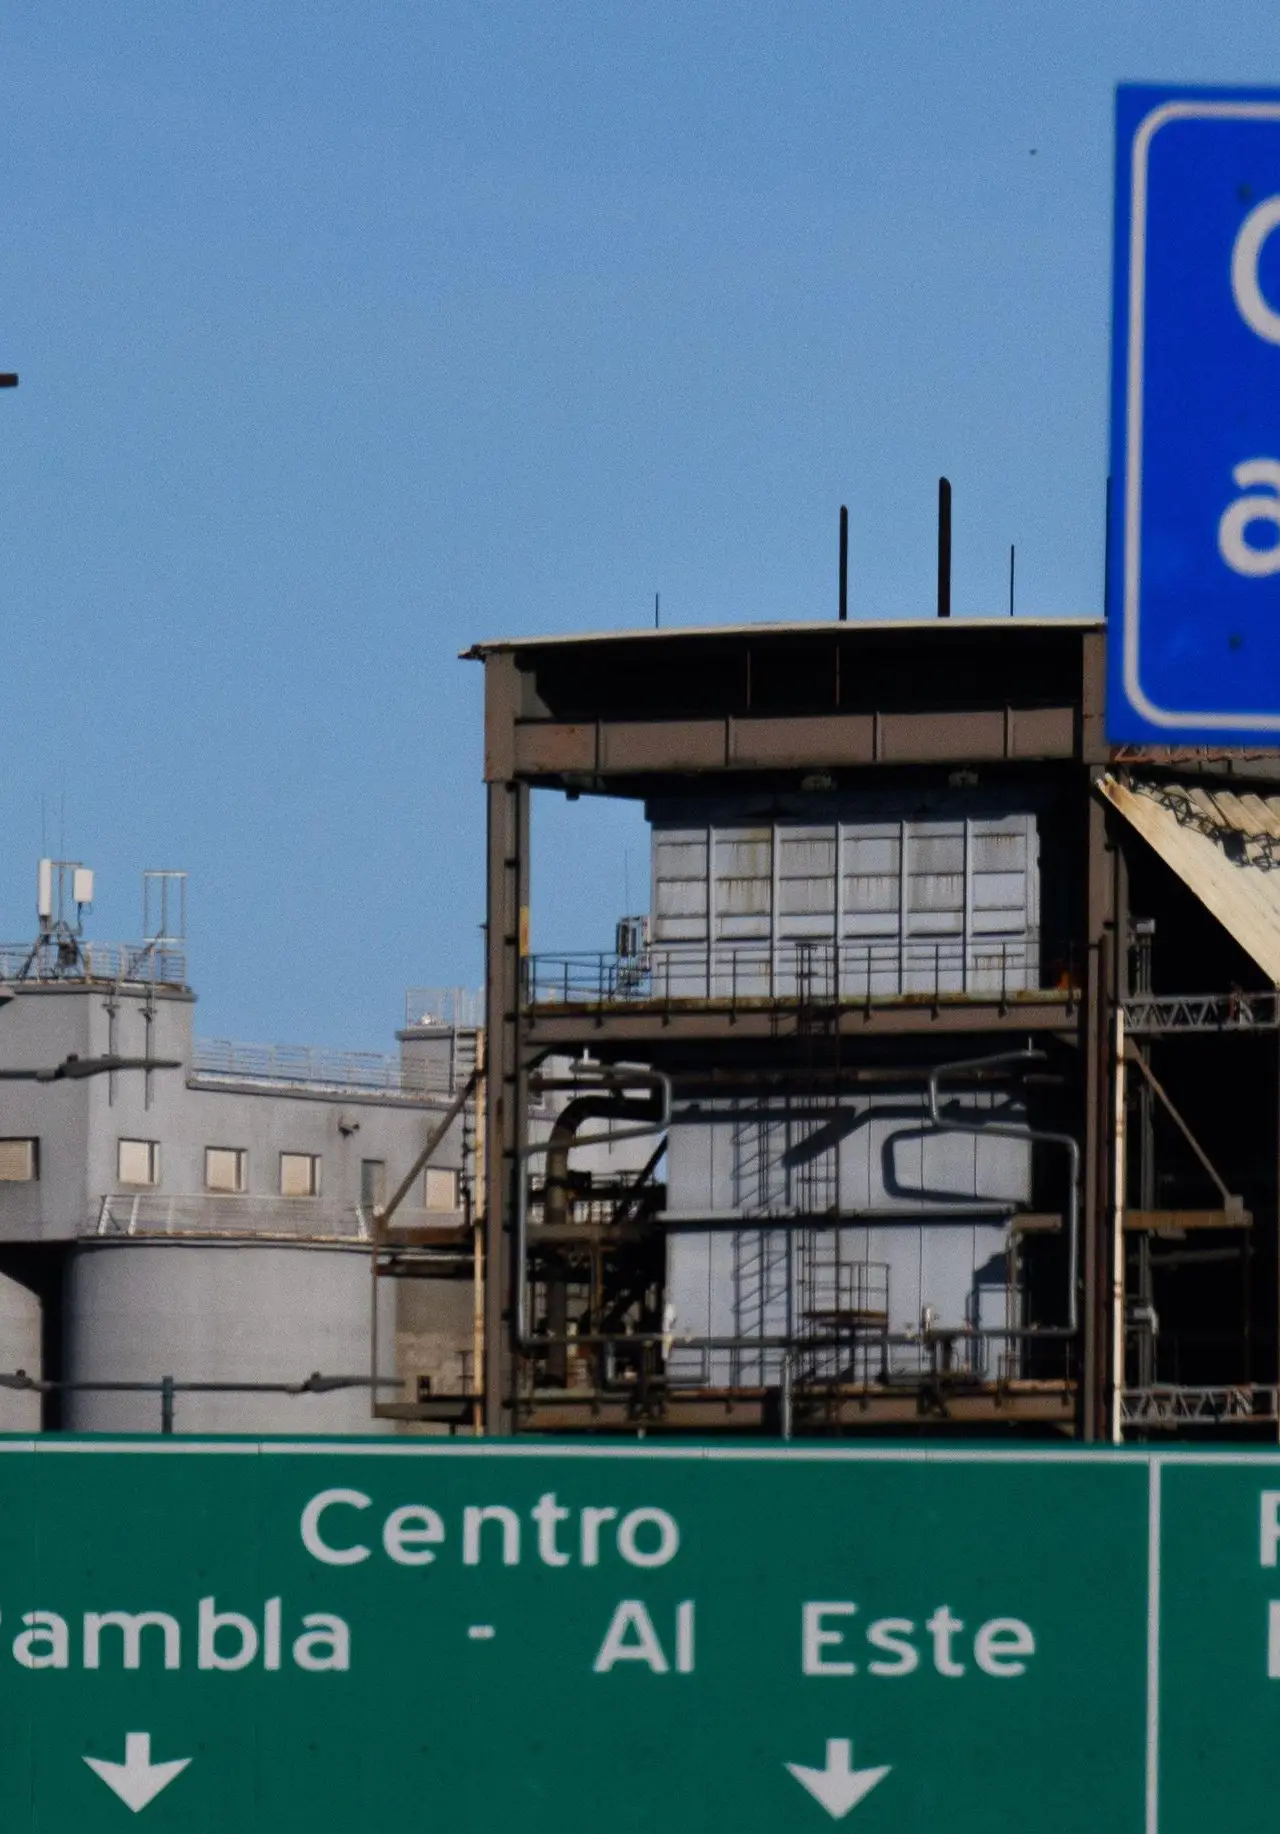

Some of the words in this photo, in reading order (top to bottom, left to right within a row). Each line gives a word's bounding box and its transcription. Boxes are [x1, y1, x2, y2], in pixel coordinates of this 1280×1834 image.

[299, 1487, 680, 1568] Centro
[0, 1595, 351, 1672] ambla
[467, 1624, 496, 1640] -
[593, 1599, 695, 1674] Al
[801, 1600, 1036, 1678] Este
